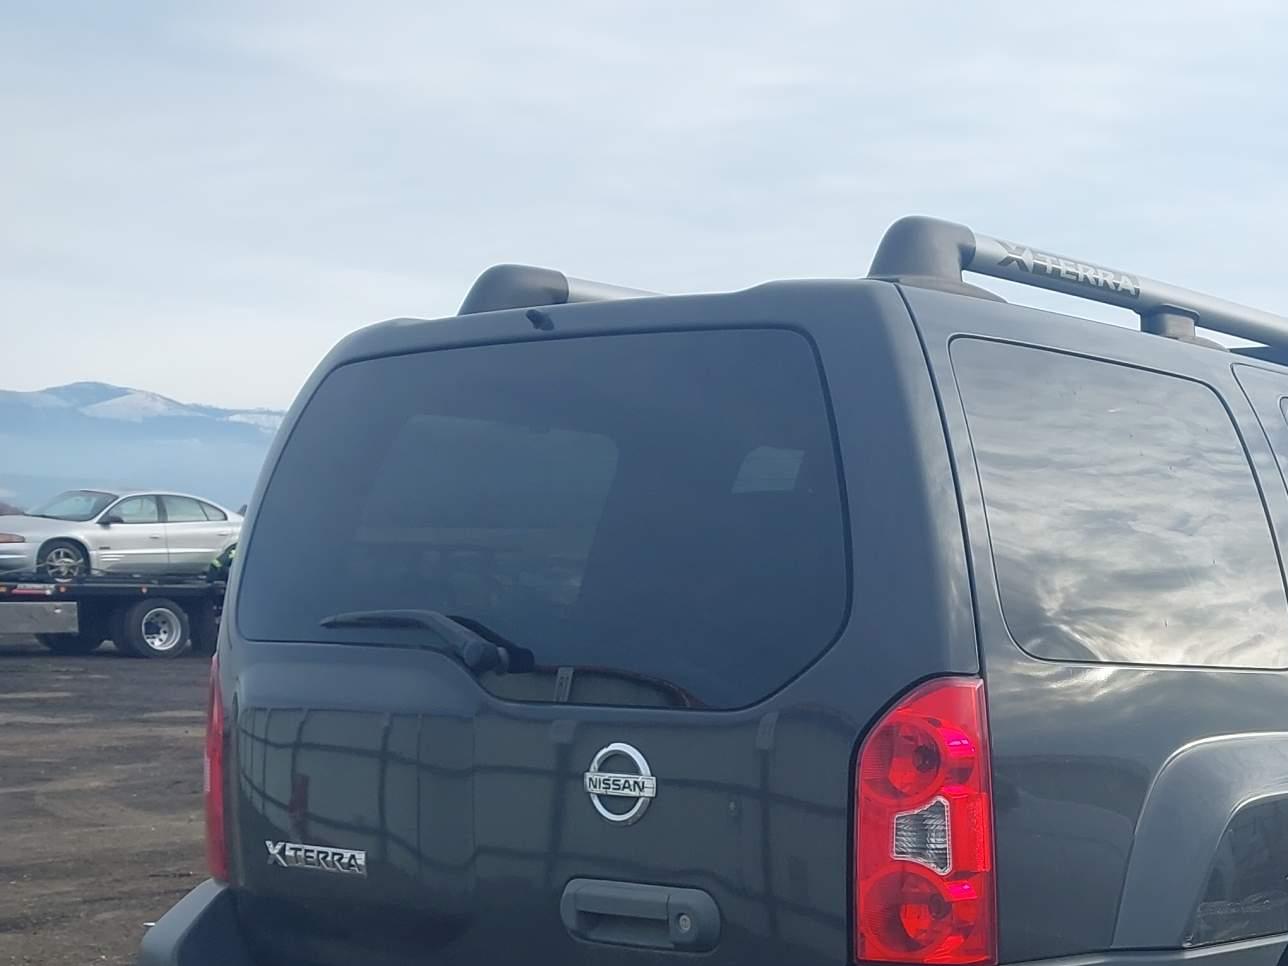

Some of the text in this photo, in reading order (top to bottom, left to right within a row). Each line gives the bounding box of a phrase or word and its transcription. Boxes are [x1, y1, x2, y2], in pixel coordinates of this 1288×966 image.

[995, 239, 1140, 299] XTERRA
[587, 777, 646, 793] NISSAN
[264, 840, 367, 876] XTERRA
